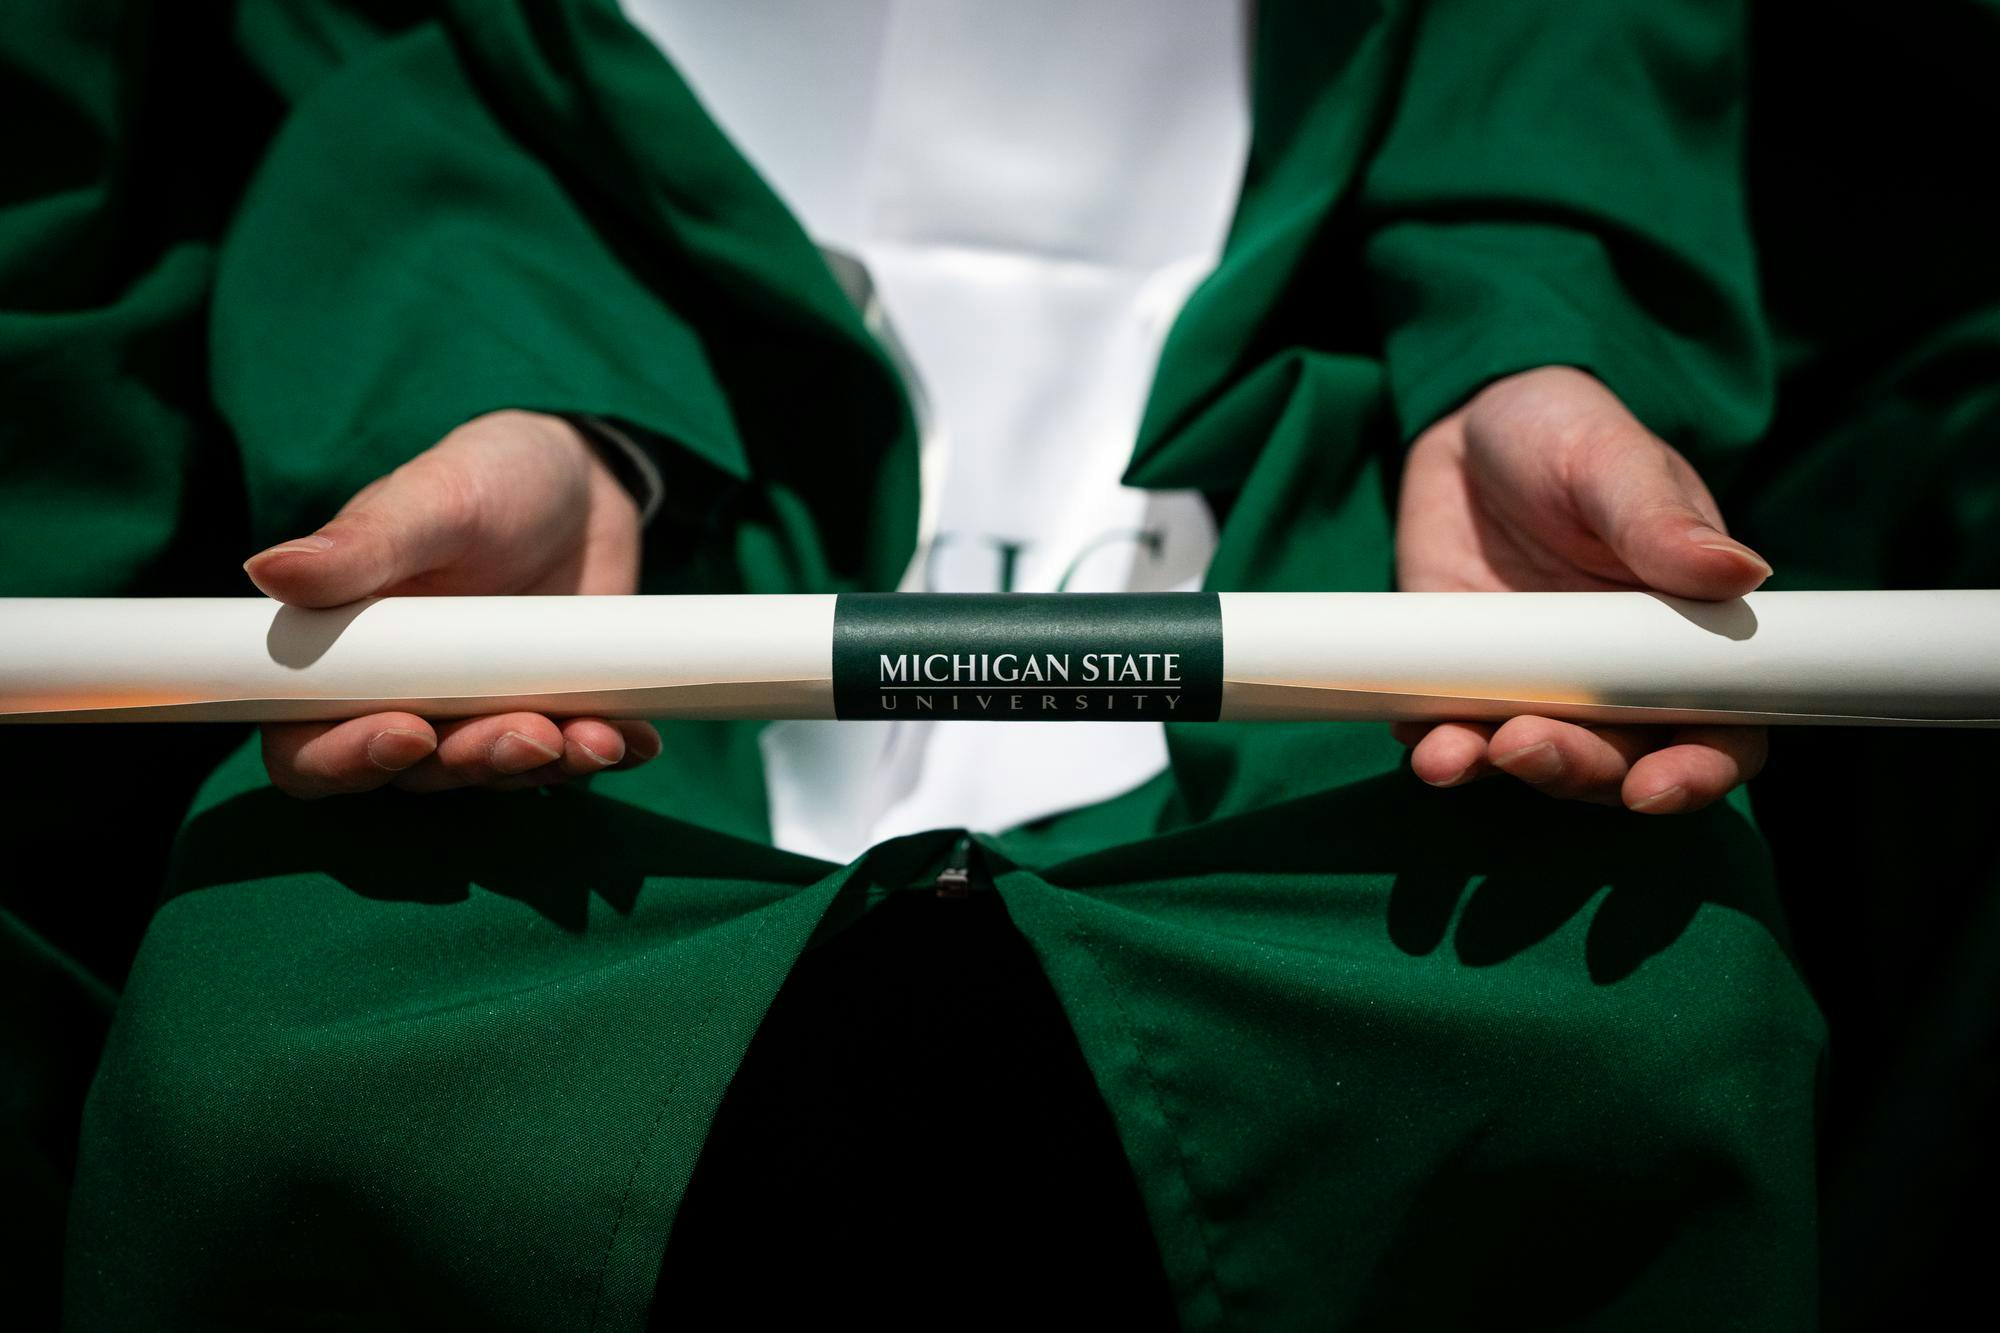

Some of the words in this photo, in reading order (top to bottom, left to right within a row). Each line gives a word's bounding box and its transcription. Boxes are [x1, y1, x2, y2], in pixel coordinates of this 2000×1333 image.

[880, 654, 1069, 682] MICHIGAN
[1082, 653, 1181, 682] STATE
[881, 695, 1182, 710] UNIVERSITY
